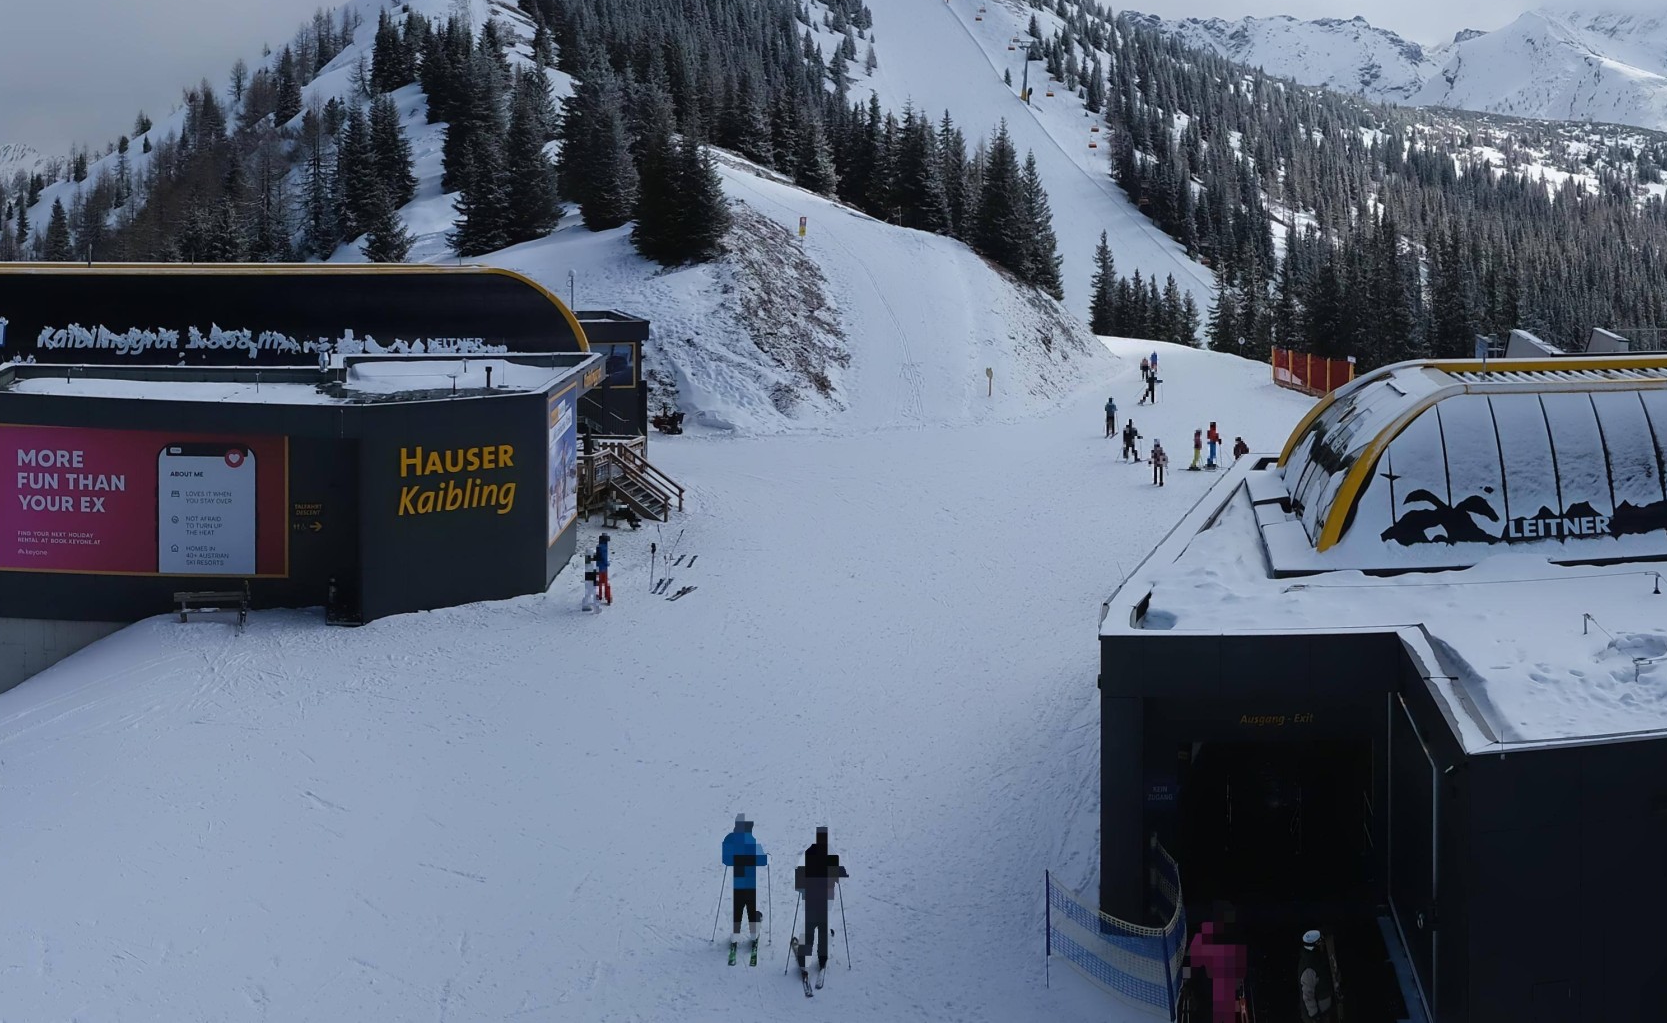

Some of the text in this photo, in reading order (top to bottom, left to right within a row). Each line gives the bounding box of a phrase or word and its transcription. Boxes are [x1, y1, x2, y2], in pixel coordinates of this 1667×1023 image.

[17, 449, 84, 468] MORE
[400, 444, 514, 477] HAUSER
[17, 472, 125, 491] FUN THAN
[18, 495, 105, 513] YOUR EX
[398, 478, 516, 515] Kaibling
[1509, 516, 1611, 537] LEITNER
[1240, 715, 1285, 726] Ausgang
[1294, 713, 1314, 723] Exit
